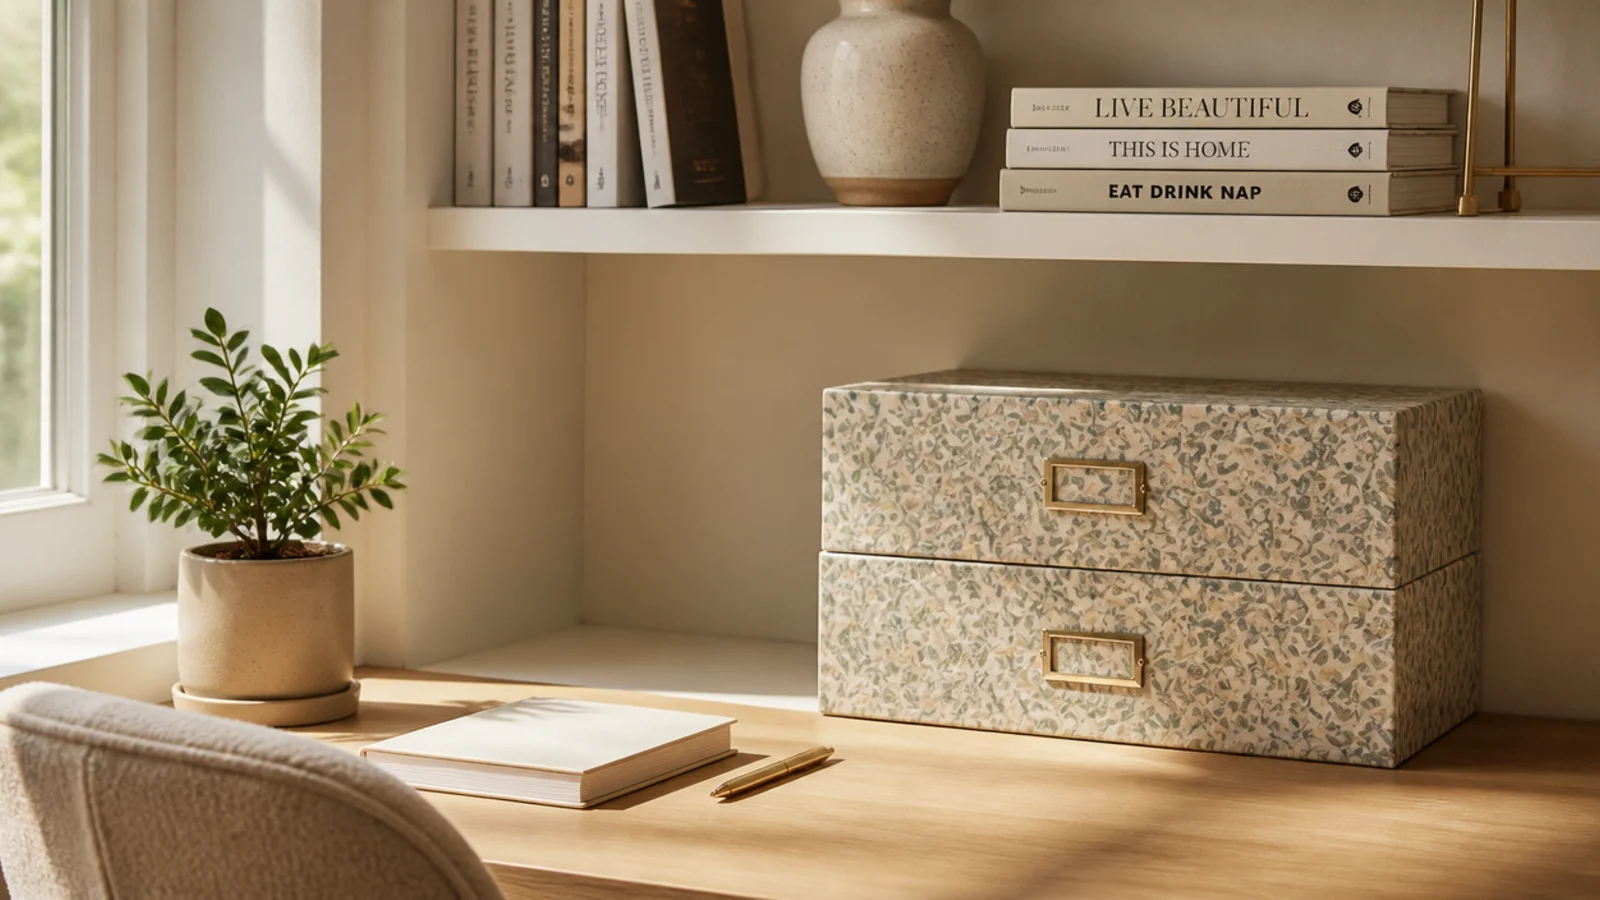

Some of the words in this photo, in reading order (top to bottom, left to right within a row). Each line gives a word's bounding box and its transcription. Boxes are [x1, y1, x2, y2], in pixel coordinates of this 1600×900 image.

[1095, 97, 1154, 119] LIVE
[1161, 96, 1310, 119] BEAUTIFUL
[1108, 140, 1156, 158] THIS
[1161, 140, 1180, 158] IS
[1184, 140, 1251, 159] HOME
[1108, 183, 1144, 199] EAT
[1150, 184, 1214, 200] DRINK
[1220, 185, 1262, 200] NAP
